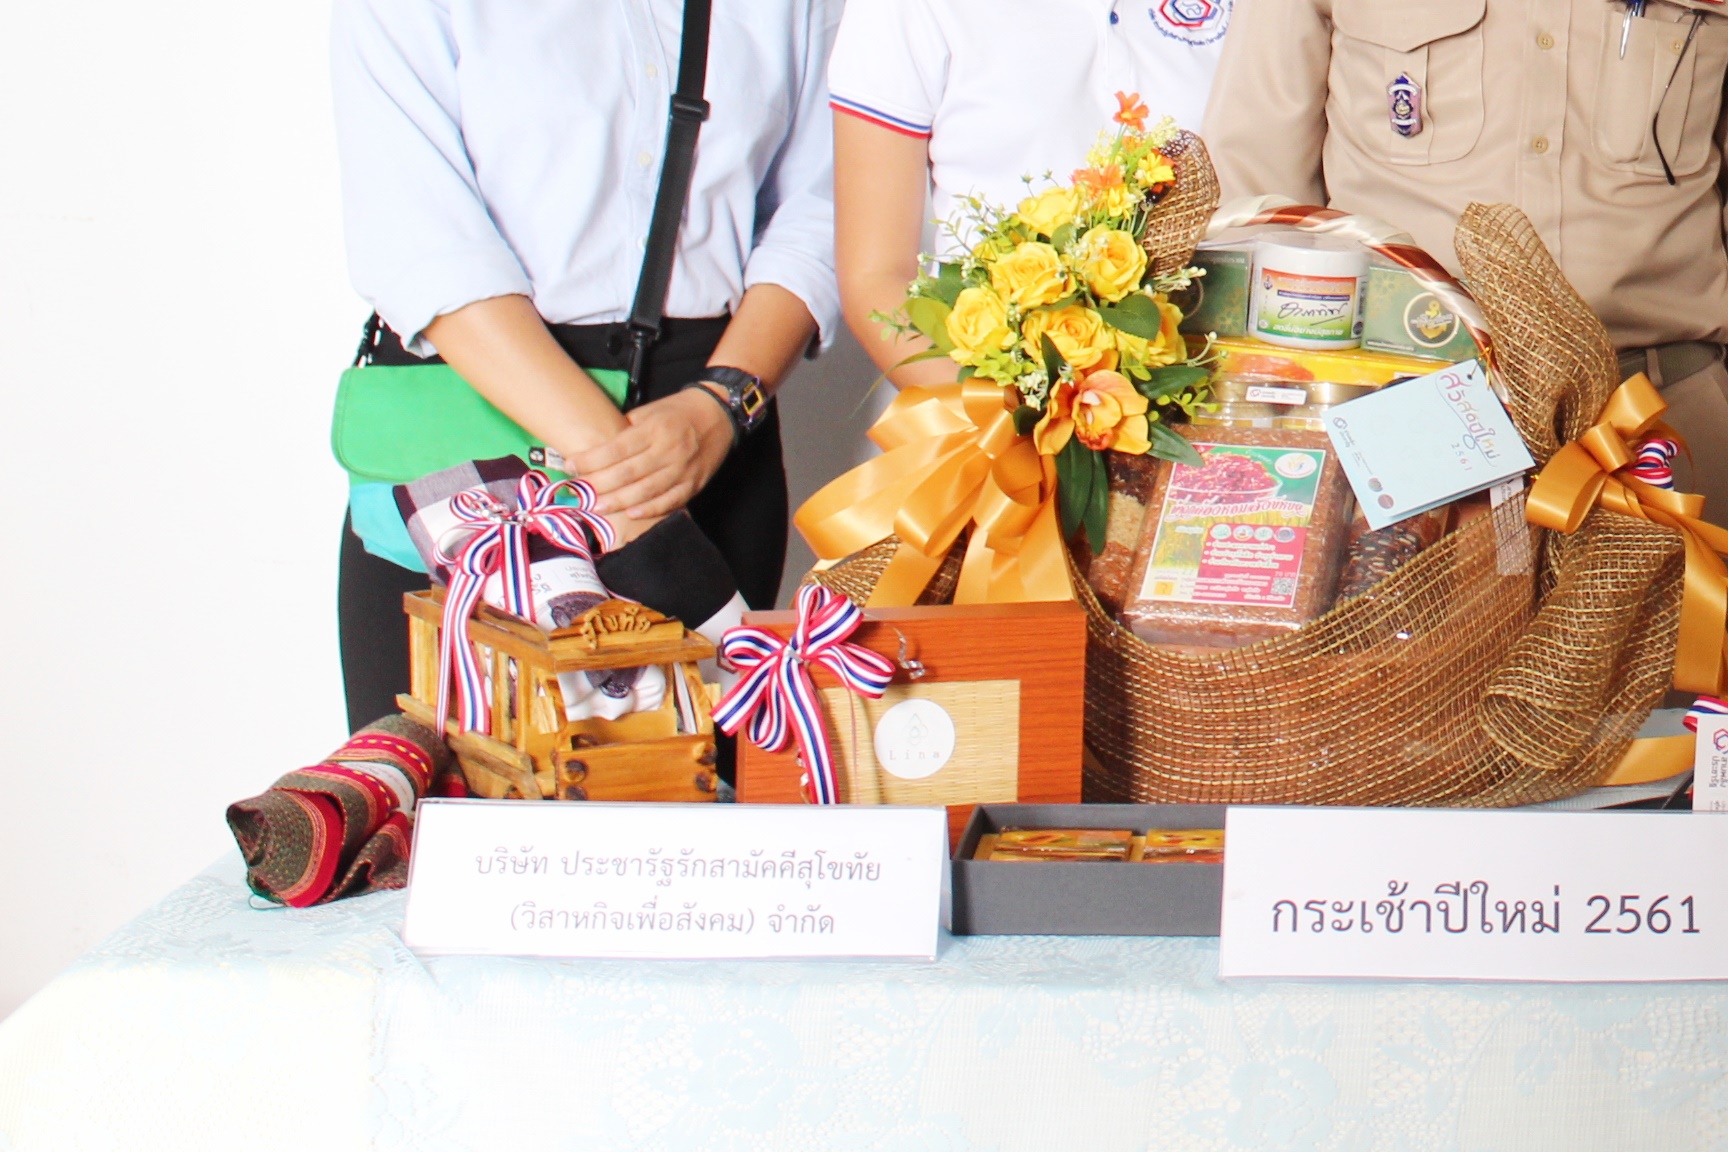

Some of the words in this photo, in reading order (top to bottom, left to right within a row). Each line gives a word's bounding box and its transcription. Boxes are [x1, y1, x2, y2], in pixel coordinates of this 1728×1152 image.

[475, 846, 548, 875] บริษัท
[561, 848, 881, 889] ประชารัฐรักสามัคคีสุโขทัย
[510, 895, 755, 934] (วิสาหกิจเพื่อสังคม)
[768, 903, 835, 934] จำกัด
[1271, 880, 1560, 934] กระเช้าปีใหม่
[1584, 894, 1701, 935] 2561
